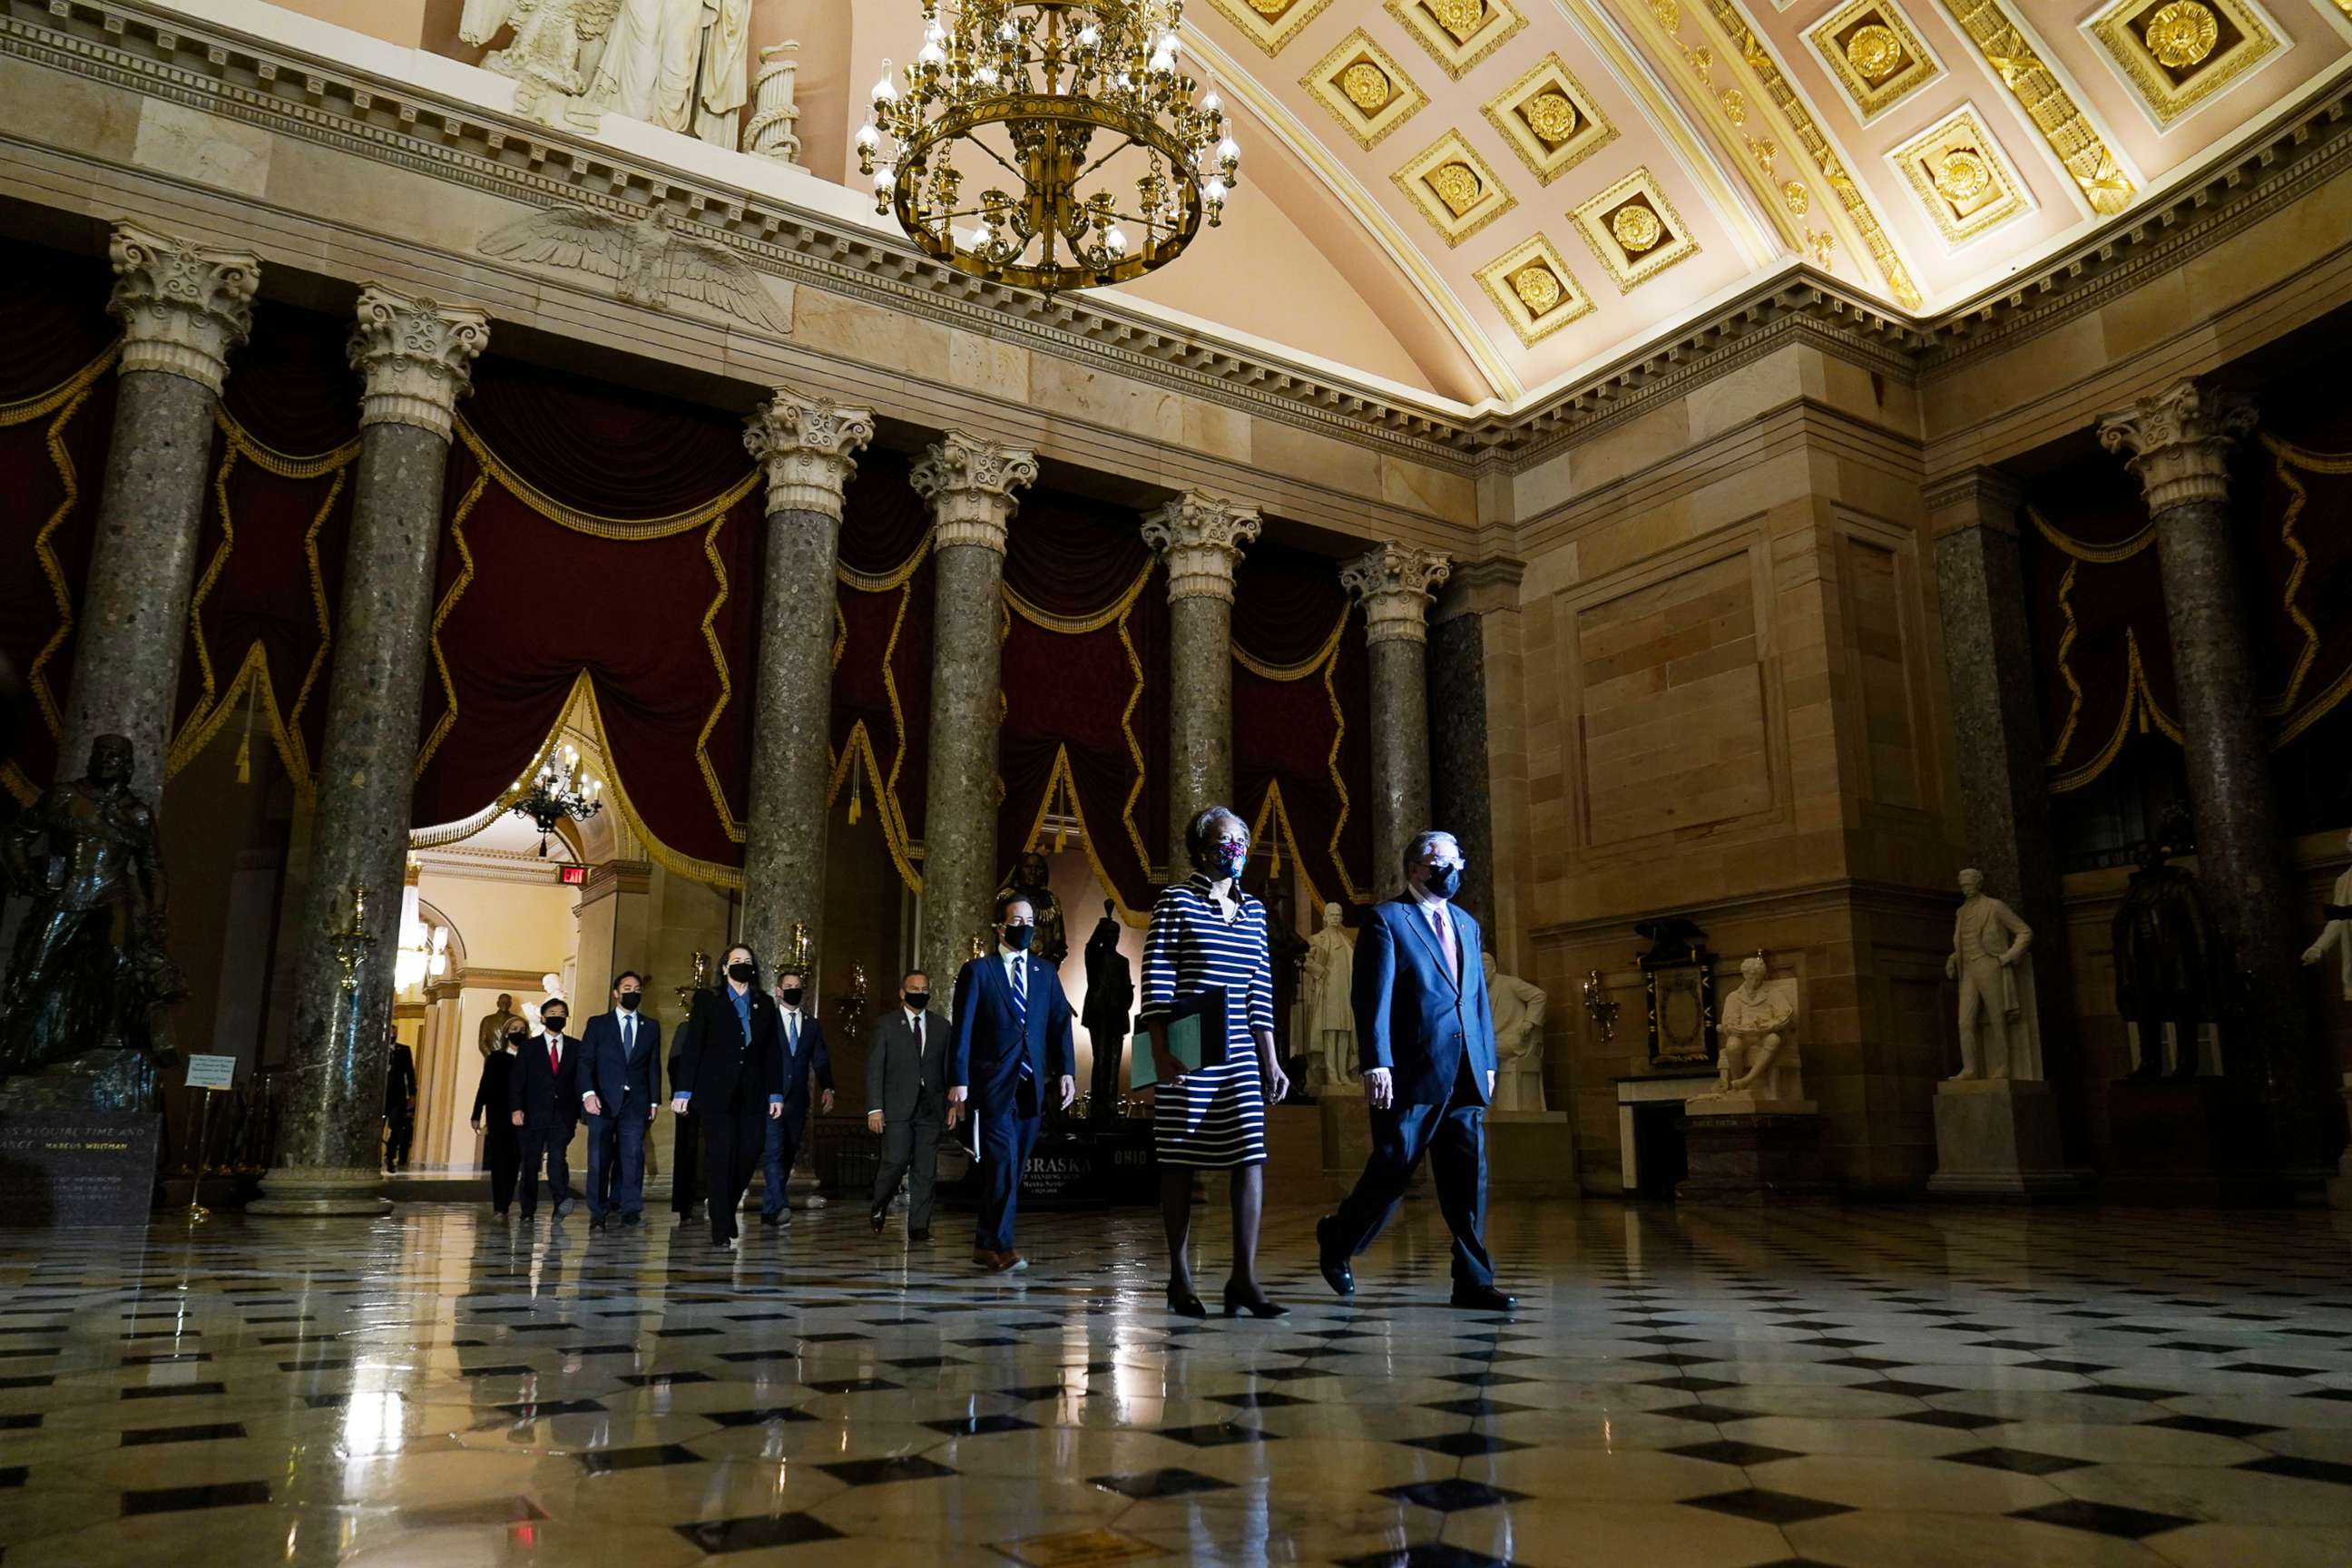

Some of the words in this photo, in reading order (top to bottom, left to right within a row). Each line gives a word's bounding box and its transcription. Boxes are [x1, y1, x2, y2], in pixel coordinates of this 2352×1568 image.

[564, 868, 583, 883] EXIT
[85, 1126, 115, 1137] TIME
[117, 1127, 145, 1137] AND
[44, 1142, 82, 1150] MARCUS
[85, 1142, 129, 1150] WHITMAN
[1113, 1149, 1148, 1165] OHIO
